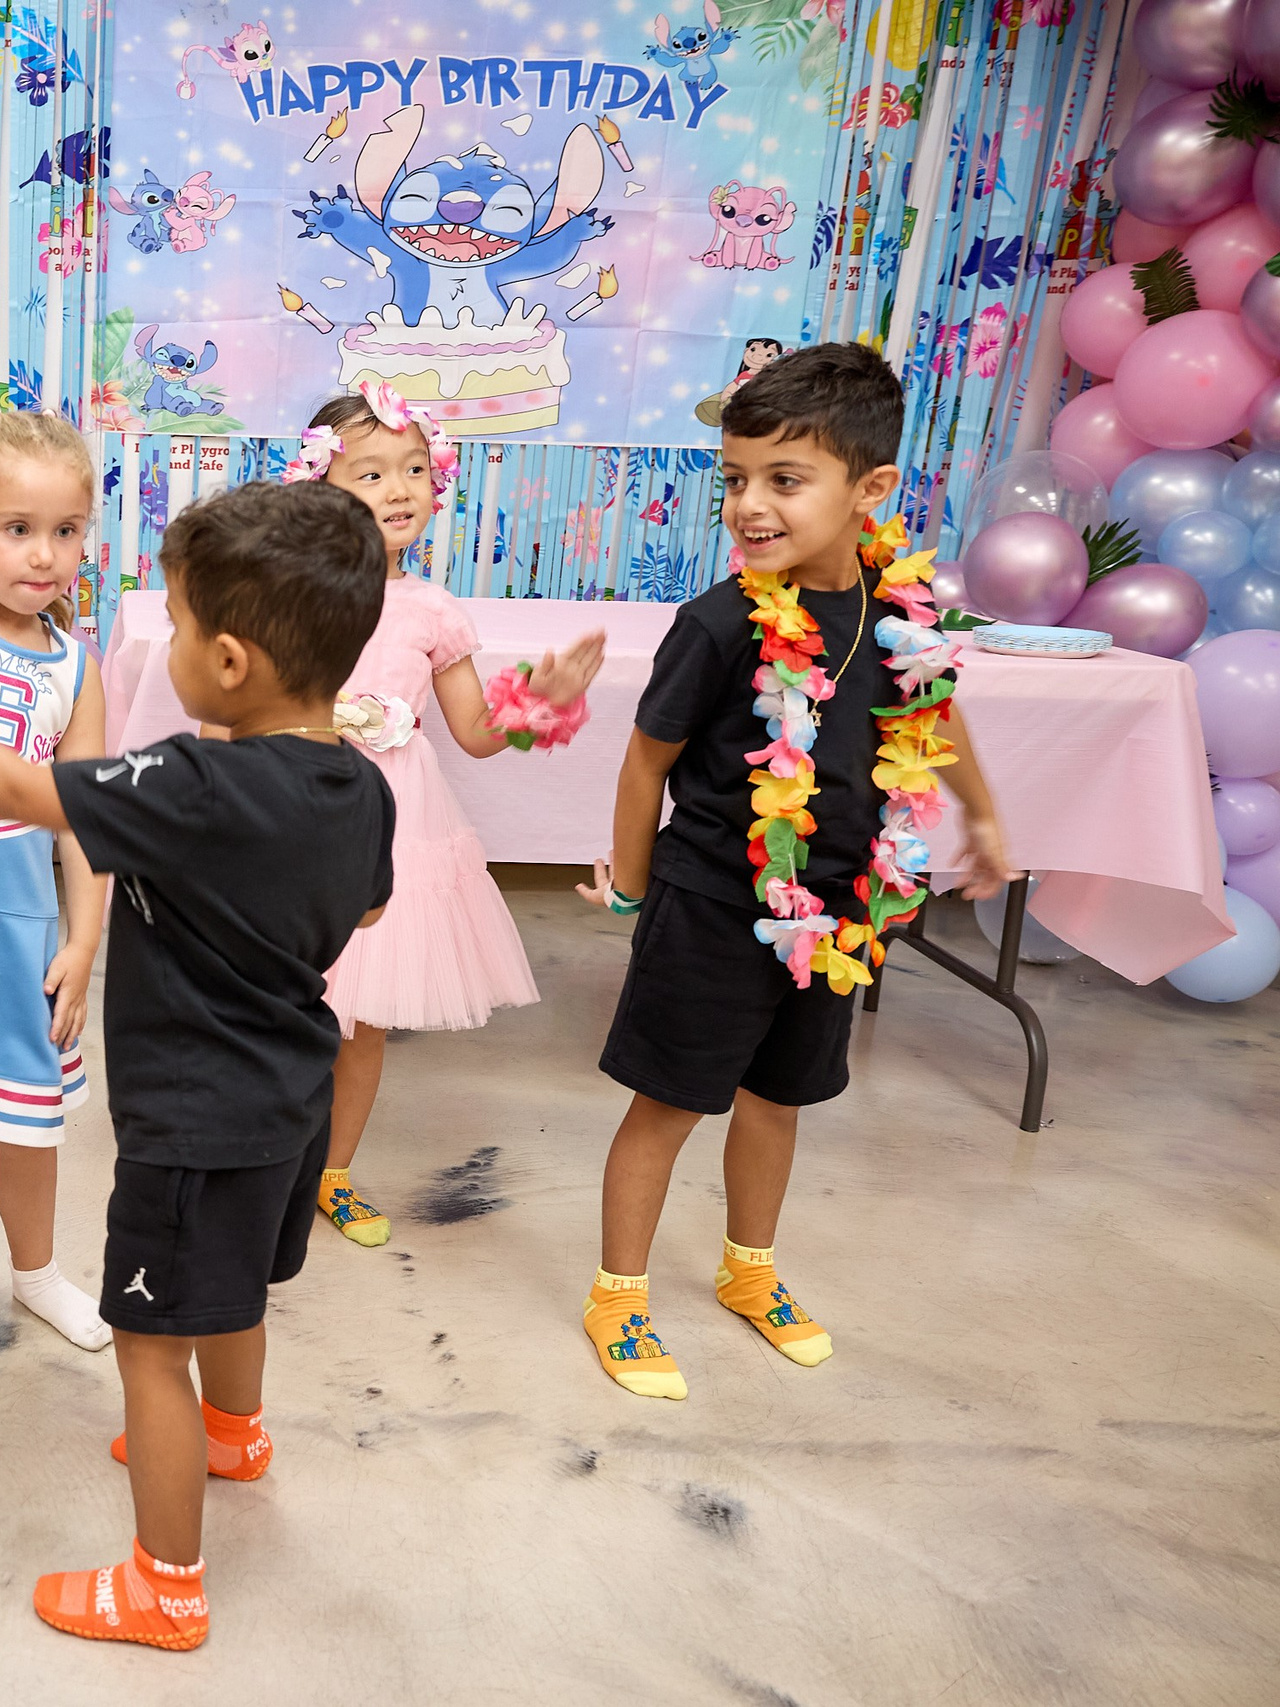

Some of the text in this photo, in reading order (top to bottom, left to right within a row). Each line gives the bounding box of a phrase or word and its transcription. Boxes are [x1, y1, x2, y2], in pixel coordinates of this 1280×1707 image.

[239, 57, 729, 130] HAPPY BIRTHDAY
[488, 452, 503, 463] nd
[159, 1594, 202, 1608] HAVE
